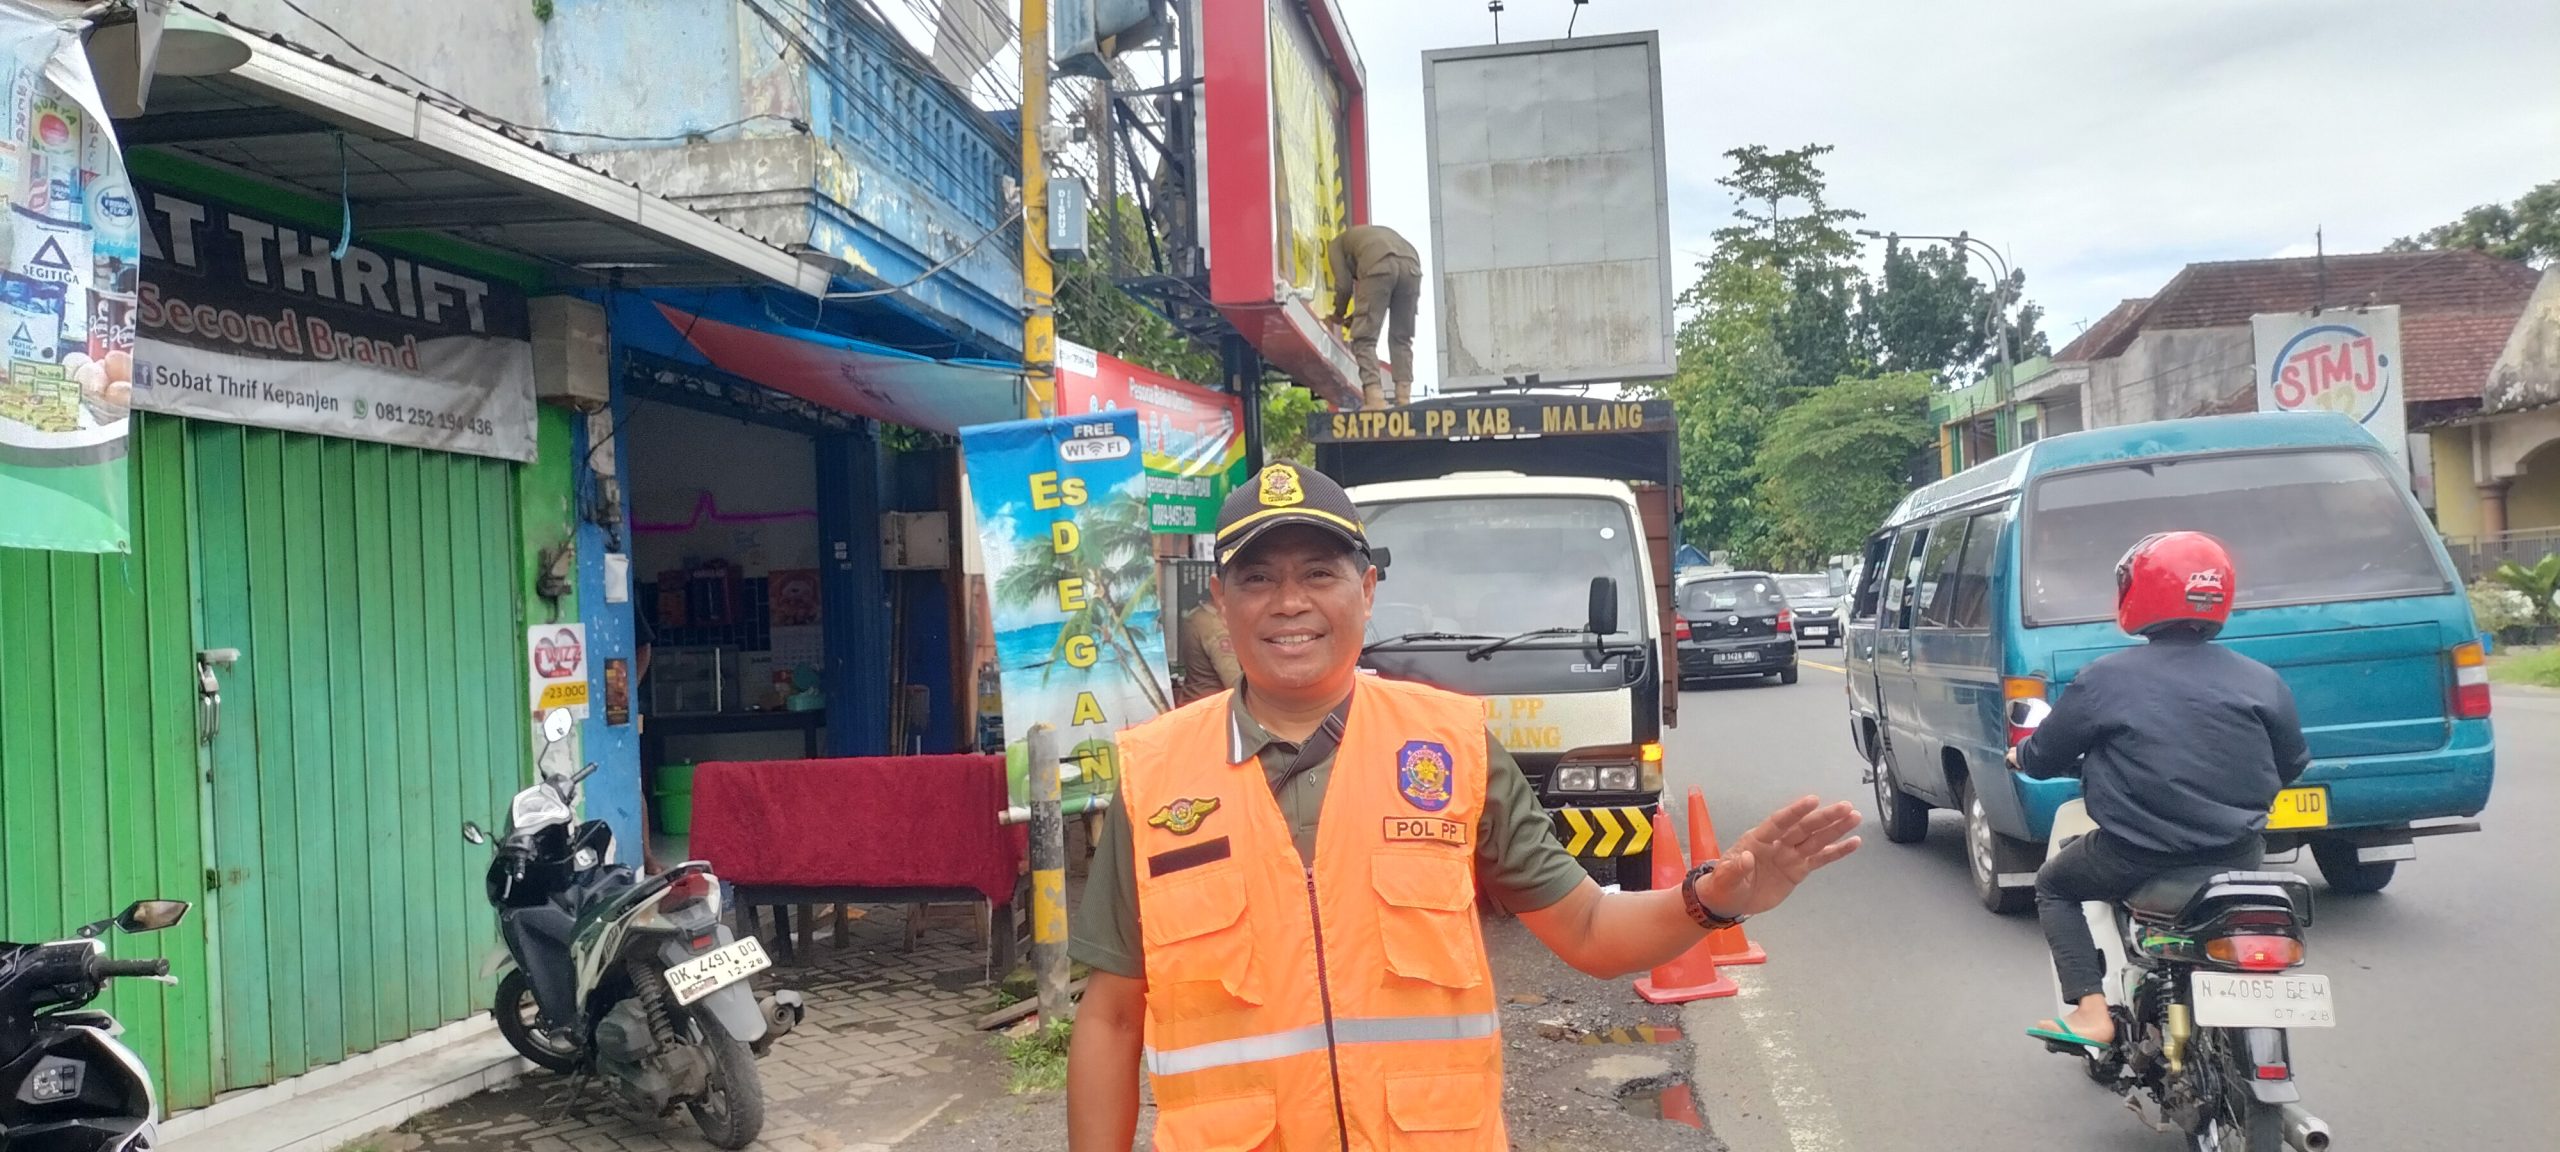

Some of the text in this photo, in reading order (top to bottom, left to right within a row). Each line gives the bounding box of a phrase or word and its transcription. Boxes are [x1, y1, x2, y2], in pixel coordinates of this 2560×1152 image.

[22, 265, 80, 285] SEGITIGA
[228, 213, 489, 333] THRIFT
[138, 281, 303, 354] Second
[307, 317, 421, 374] Brand
[2274, 337, 2377, 408] STMJ
[156, 365, 212, 393] Sobat
[217, 375, 257, 399] Thrif
[263, 382, 339, 412] Kepanjen
[376, 403, 404, 423] 081
[409, 408, 434, 428] 252
[467, 417, 493, 436] 436
[1074, 422, 1114, 437] FREE
[1332, 410, 1416, 439] SATPOL
[1426, 409, 1456, 436] PP
[1543, 404, 1643, 433] MALANG
[1065, 442, 1121, 456] WI FI
[1571, 664, 1618, 673] ELF
[1509, 698, 1544, 719] PP
[2296, 793, 2321, 813] UD
[1397, 821, 1457, 840] POL PP
[669, 967, 692, 986] DK
[700, 951, 732, 972] 4491
[2202, 980, 2212, 997] N
[2227, 979, 2274, 999] 4065
